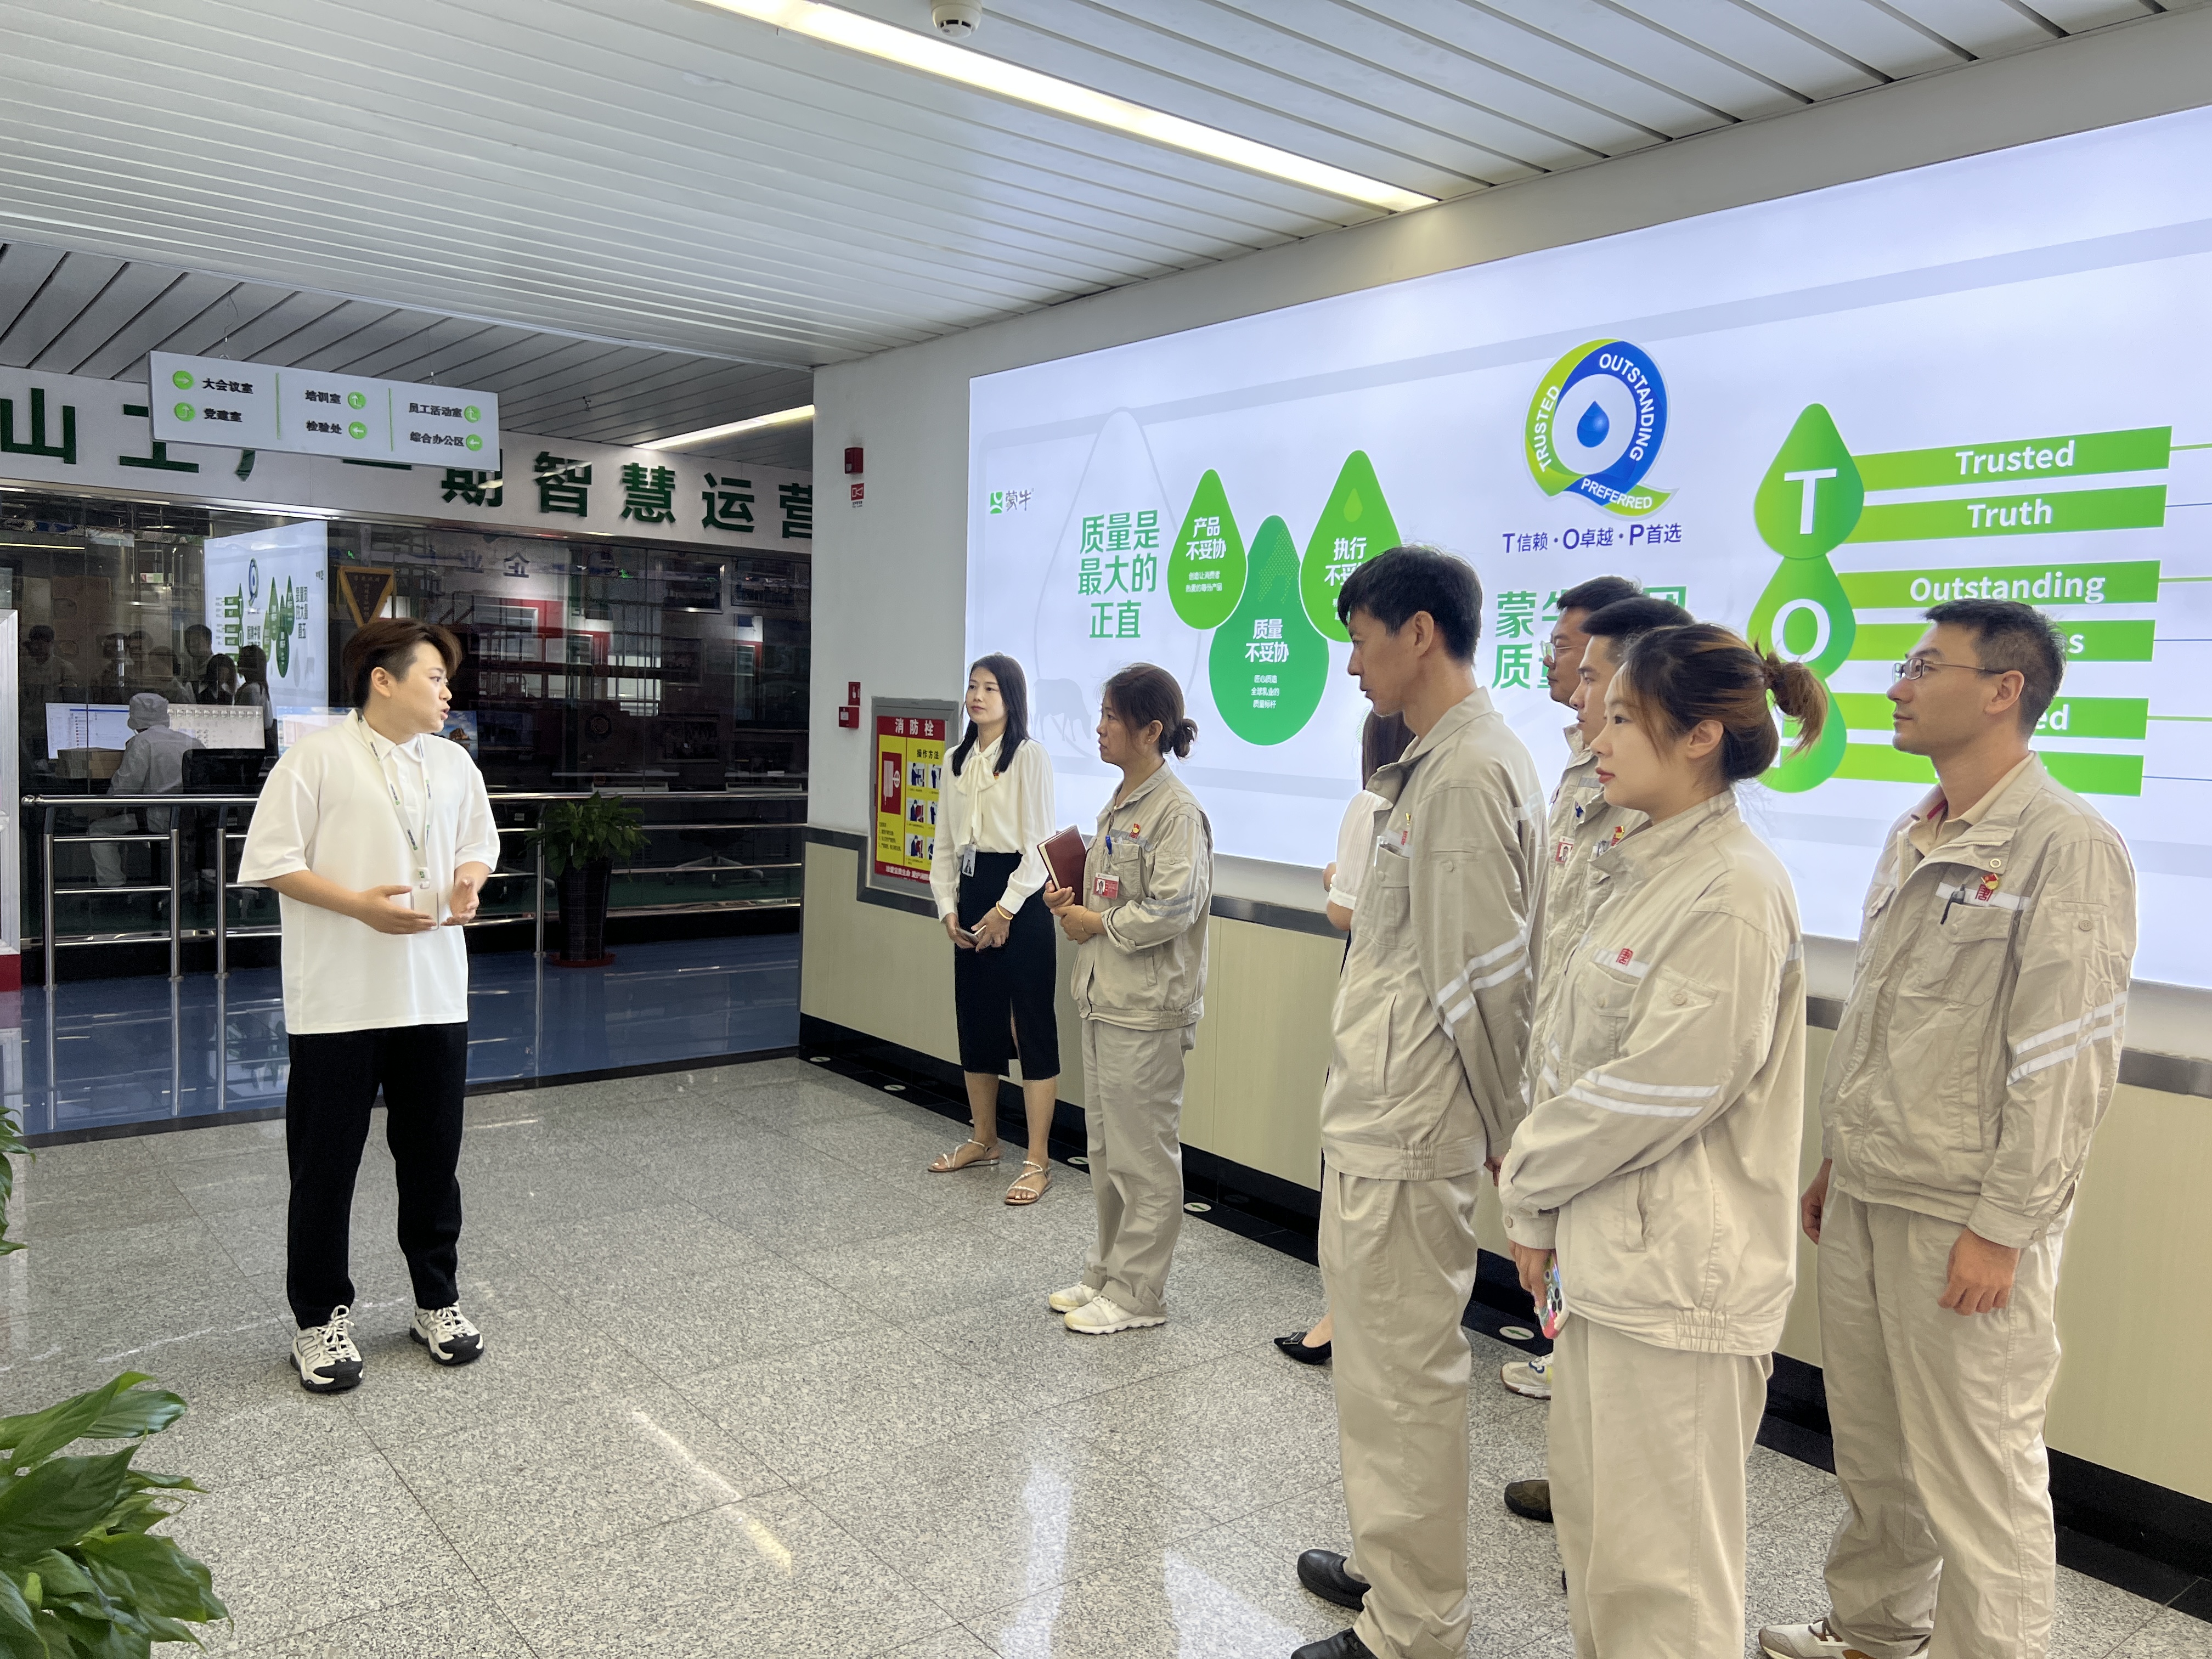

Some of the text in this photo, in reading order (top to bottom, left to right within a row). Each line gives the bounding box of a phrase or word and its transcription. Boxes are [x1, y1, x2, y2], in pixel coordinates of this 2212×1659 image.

[202, 378, 254, 394] 大会议室
[305, 390, 341, 404] 培训室
[204, 408, 243, 422] 党建室
[408, 403, 462, 418] 员工活动室
[1598, 353, 1655, 462] OUTSTANDING
[306, 420, 342, 435] 检验处
[410, 431, 465, 447] 综合办公区
[1534, 385, 1560, 472] TRUSTED
[1956, 440, 2075, 475] Trusted
[1581, 477, 1653, 510] PREFERRED
[1784, 468, 1837, 535] T
[1967, 499, 2053, 528] Truth
[1080, 509, 1160, 555] 质量是
[1193, 516, 1221, 538] 产品
[1186, 538, 1227, 561] 不妥协
[1333, 537, 1367, 561] 执行
[1077, 552, 1158, 596] 最大的
[1324, 562, 1363, 586] 不妥
[1910, 571, 2106, 604] Outstanding
[1089, 600, 1142, 638] 正直
[1252, 618, 1283, 640] 质量
[1771, 599, 1831, 663] O
[1245, 641, 1289, 663] 不妥协
[895, 718, 934, 736] 消防栓
[917, 749, 939, 760] 操作方法
